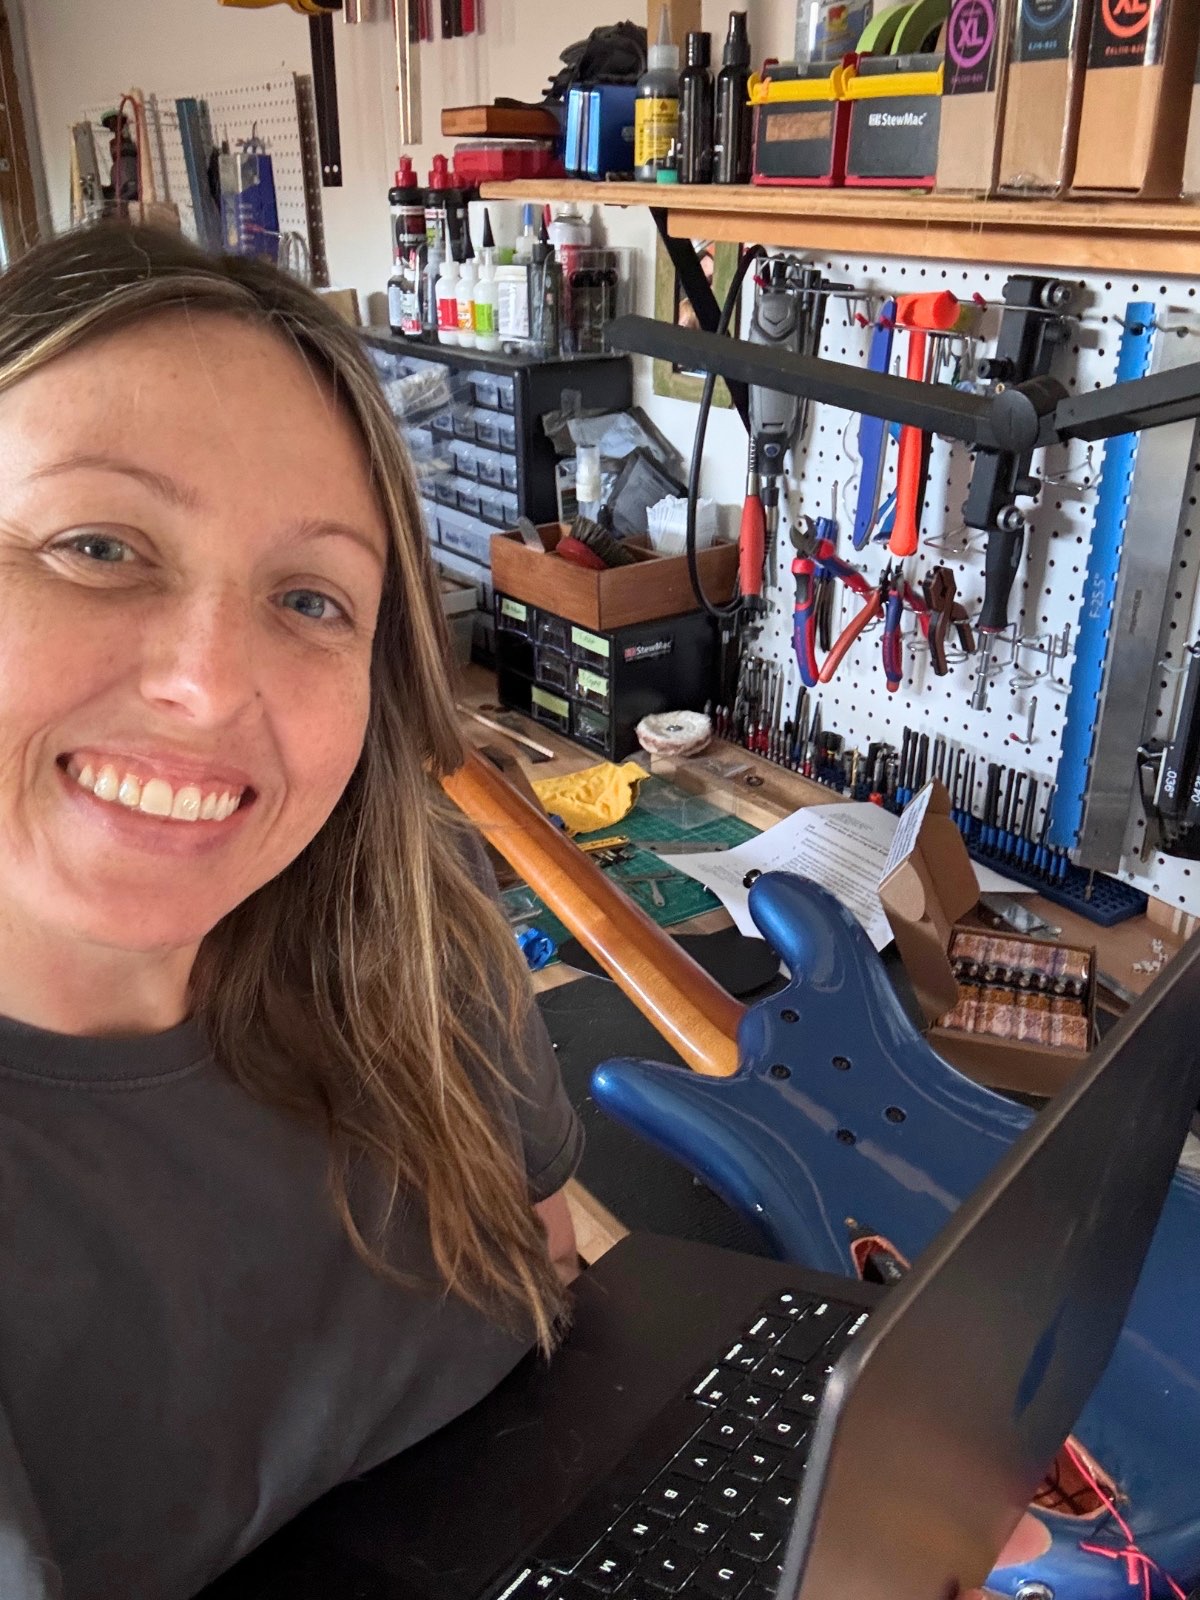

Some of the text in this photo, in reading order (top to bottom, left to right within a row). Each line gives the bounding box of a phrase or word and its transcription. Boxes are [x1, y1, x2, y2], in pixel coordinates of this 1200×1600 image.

[957, 17, 984, 49] XL
[881, 112, 925, 126] StewMac
[636, 640, 672, 655] StewMac
[771, 1367, 785, 1377] Z
[746, 1395, 761, 1405] X
[802, 1393, 816, 1402] S
[720, 1425, 734, 1435] C
[777, 1423, 791, 1433] D
[694, 1457, 708, 1467] V
[752, 1454, 765, 1464] F
[664, 1489, 679, 1499] B
[723, 1487, 738, 1498] G
[777, 1496, 792, 1505] T
[632, 1523, 649, 1535] N
[693, 1522, 709, 1534] H
[750, 1532, 764, 1541] Y
[599, 1559, 617, 1573] M
[663, 1559, 675, 1571] J
[718, 1568, 734, 1580] U
